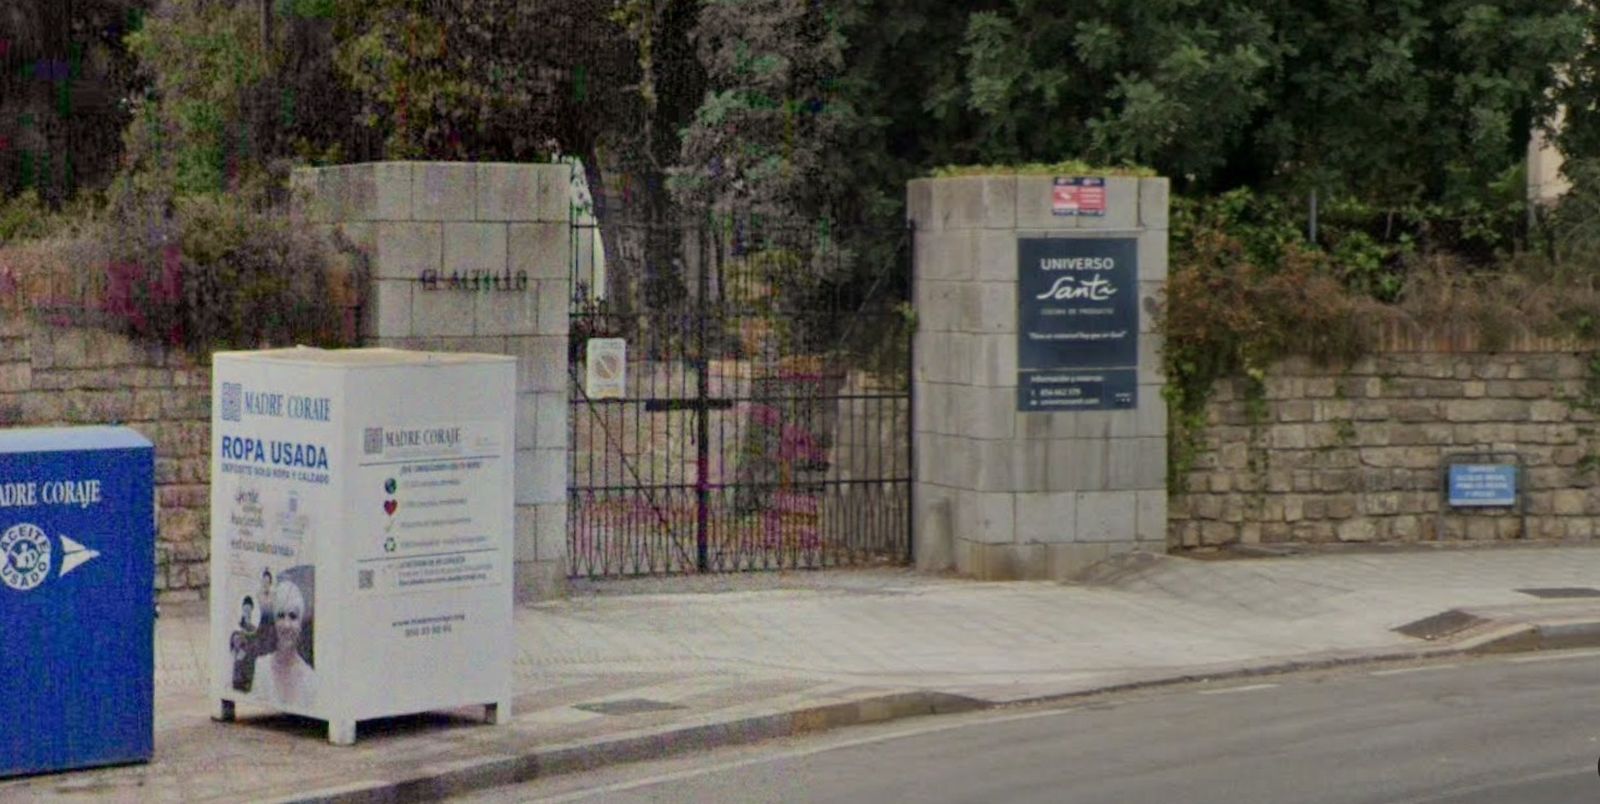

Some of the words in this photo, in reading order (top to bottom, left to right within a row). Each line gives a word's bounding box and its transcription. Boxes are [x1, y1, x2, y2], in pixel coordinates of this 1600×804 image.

[1041, 257, 1114, 270] UNIVERSO
[245, 390, 284, 417] MADRE
[287, 396, 331, 422] CORAJE
[385, 430, 420, 447] MADRE
[423, 428, 461, 448] CORAJE
[222, 436, 265, 462] ROPA
[271, 441, 328, 470] USADA
[0, 482, 37, 507] ADRE
[42, 480, 102, 509] CORAJE
[1, 526, 49, 552] ACEITE
[2, 561, 47, 587] USADO
